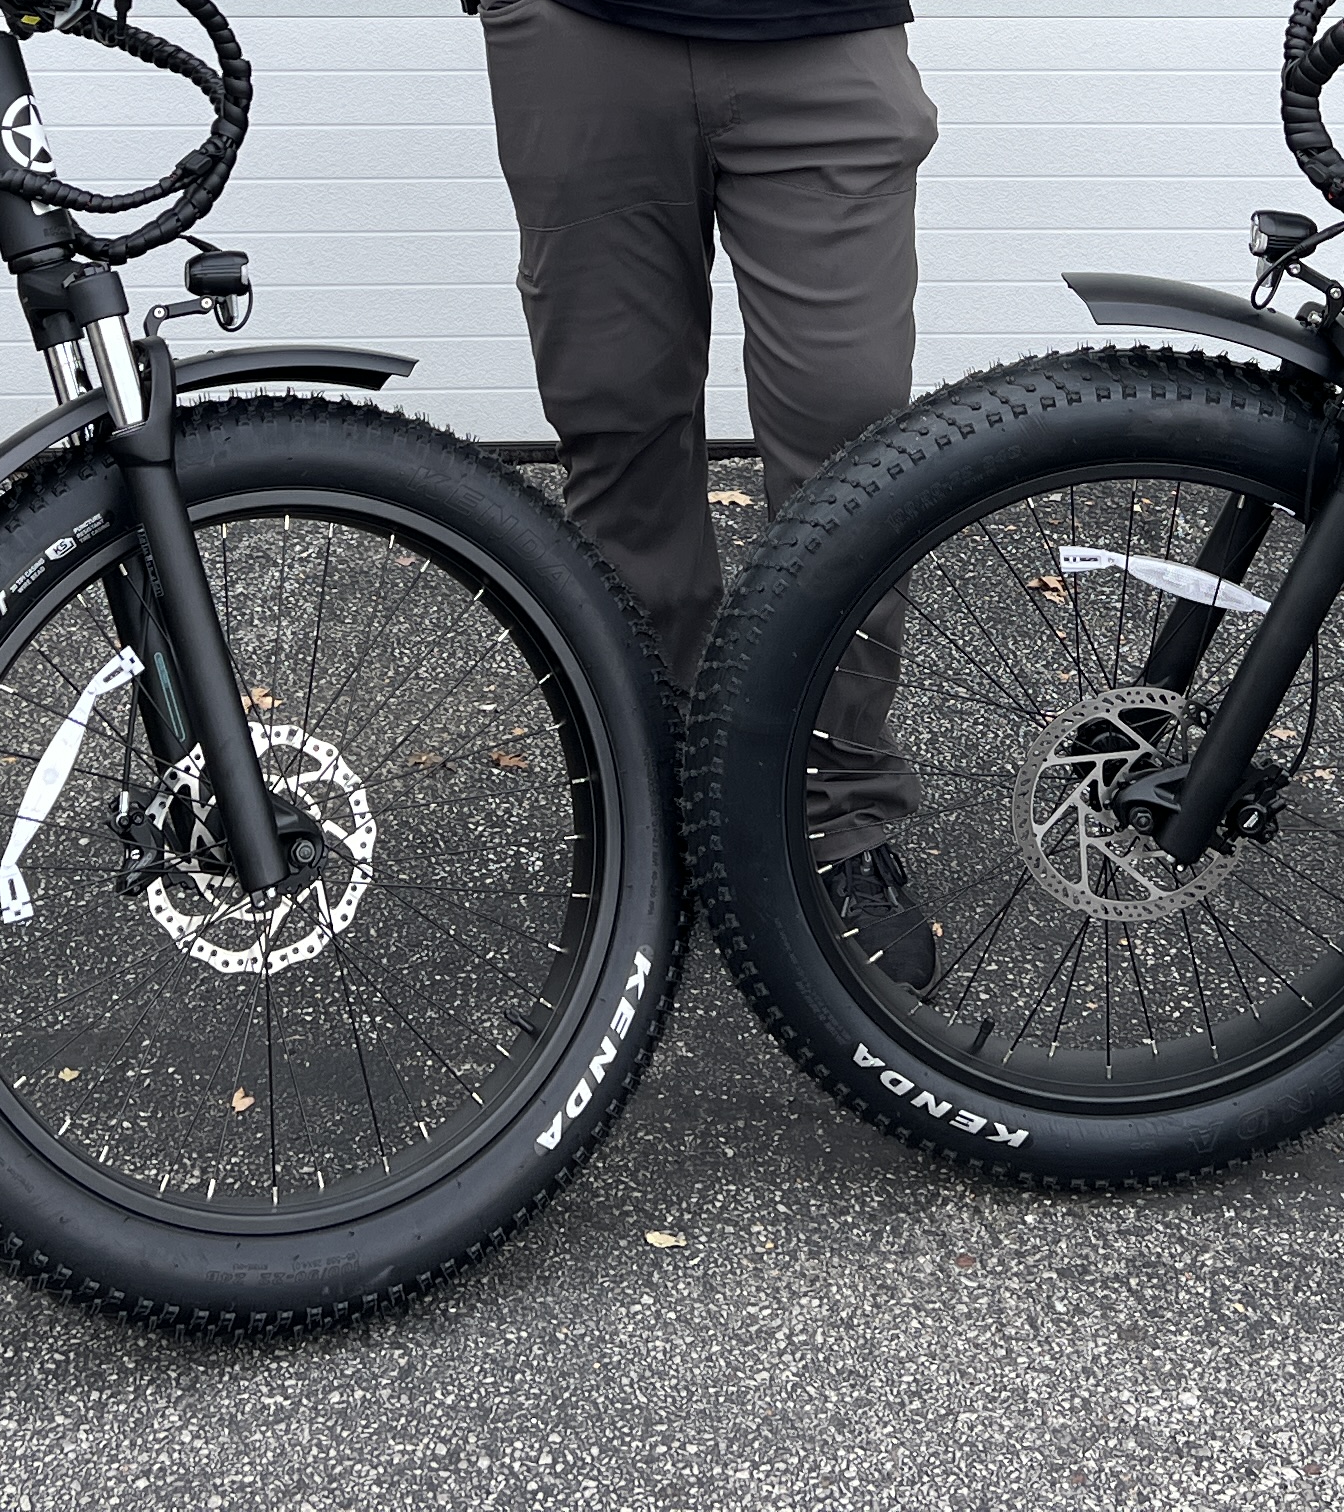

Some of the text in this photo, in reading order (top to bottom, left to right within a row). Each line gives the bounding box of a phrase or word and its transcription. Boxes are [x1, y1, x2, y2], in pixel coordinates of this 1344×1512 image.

[407, 466, 572, 594] KENDA
[536, 951, 652, 1149] KENDA
[853, 1042, 1029, 1148] KENDA
